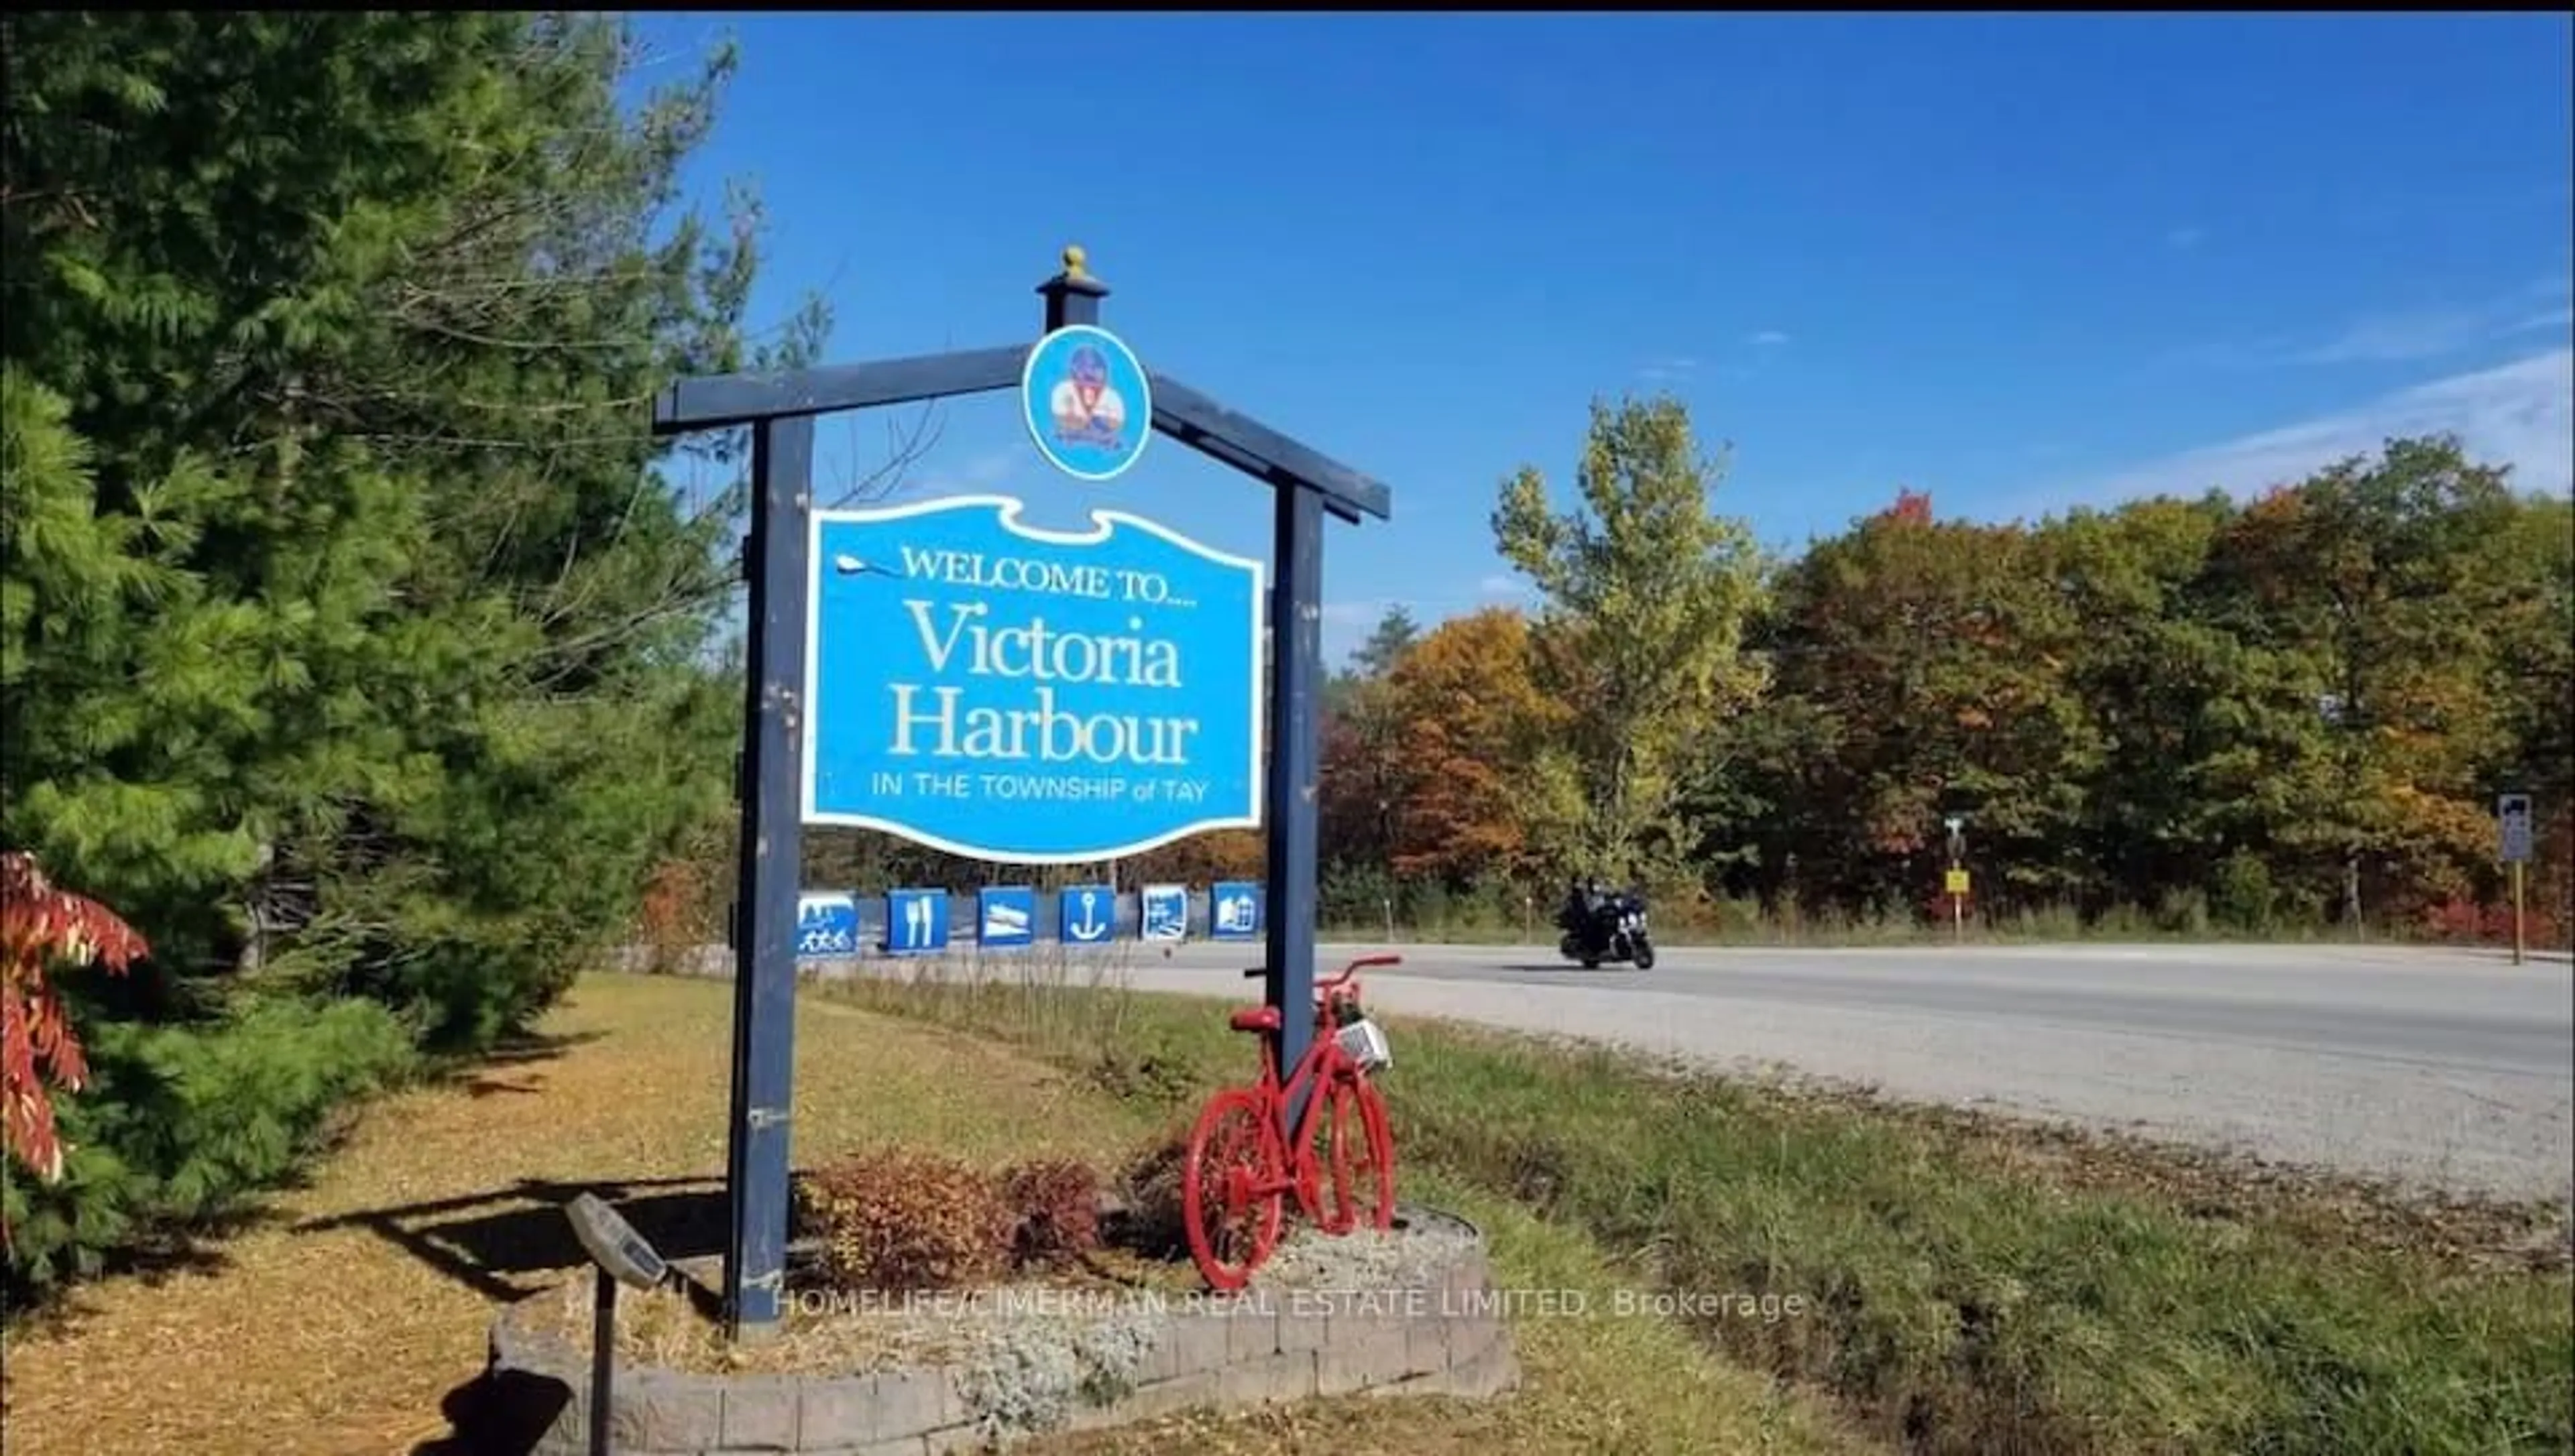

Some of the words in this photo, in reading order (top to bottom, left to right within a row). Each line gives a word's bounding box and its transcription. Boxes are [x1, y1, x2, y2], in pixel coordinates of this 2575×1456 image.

[901, 546, 1109, 600] WELCOME
[903, 600, 1182, 688] Victoria
[888, 683, 1198, 764] Harbour
[873, 772, 903, 796] IN
[913, 772, 970, 798] THE
[980, 774, 1126, 800] TOWNSHIP
[1133, 780, 1155, 801] of
[1165, 779, 1207, 804] TAY
